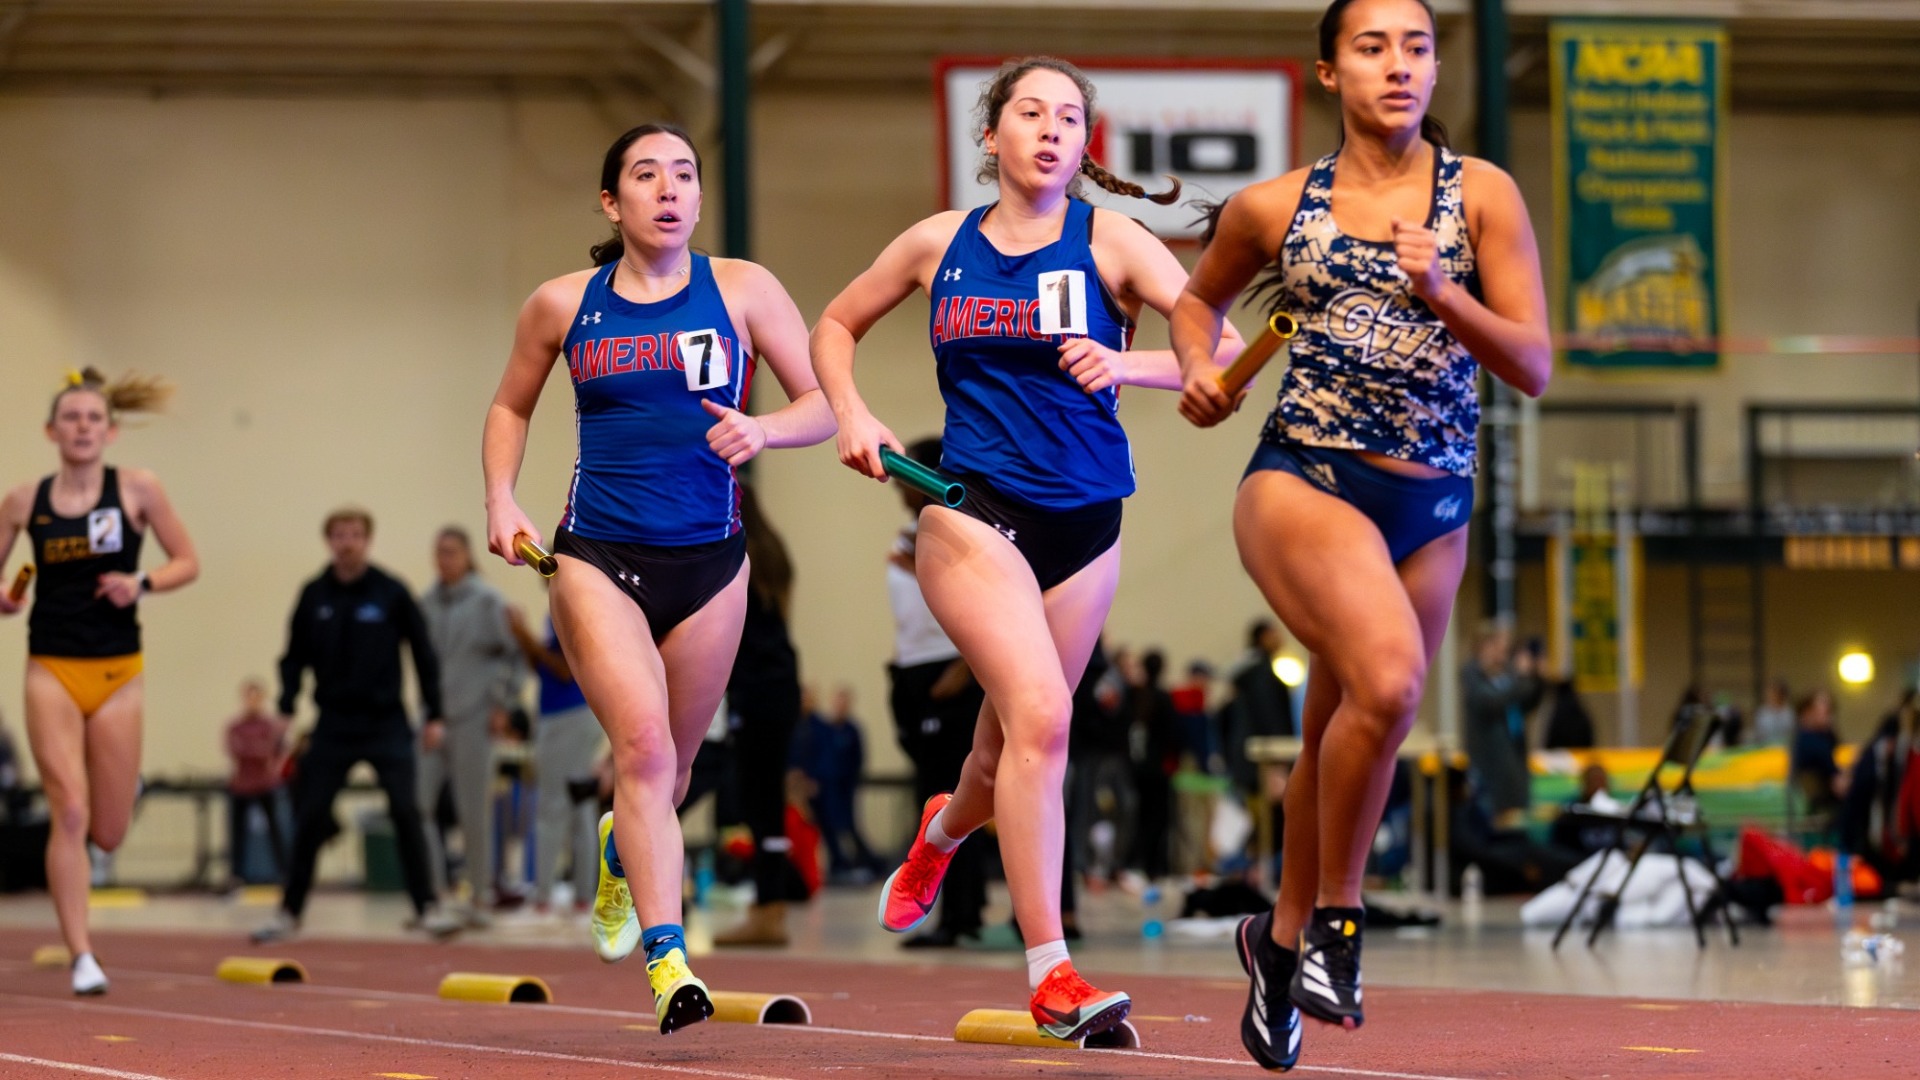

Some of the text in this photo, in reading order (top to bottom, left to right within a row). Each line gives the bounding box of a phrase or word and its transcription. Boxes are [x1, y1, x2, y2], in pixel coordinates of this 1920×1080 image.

[1576, 42, 1704, 84] NCAA
[1047, 274, 1071, 328] 1
[685, 333, 713, 386] 7
